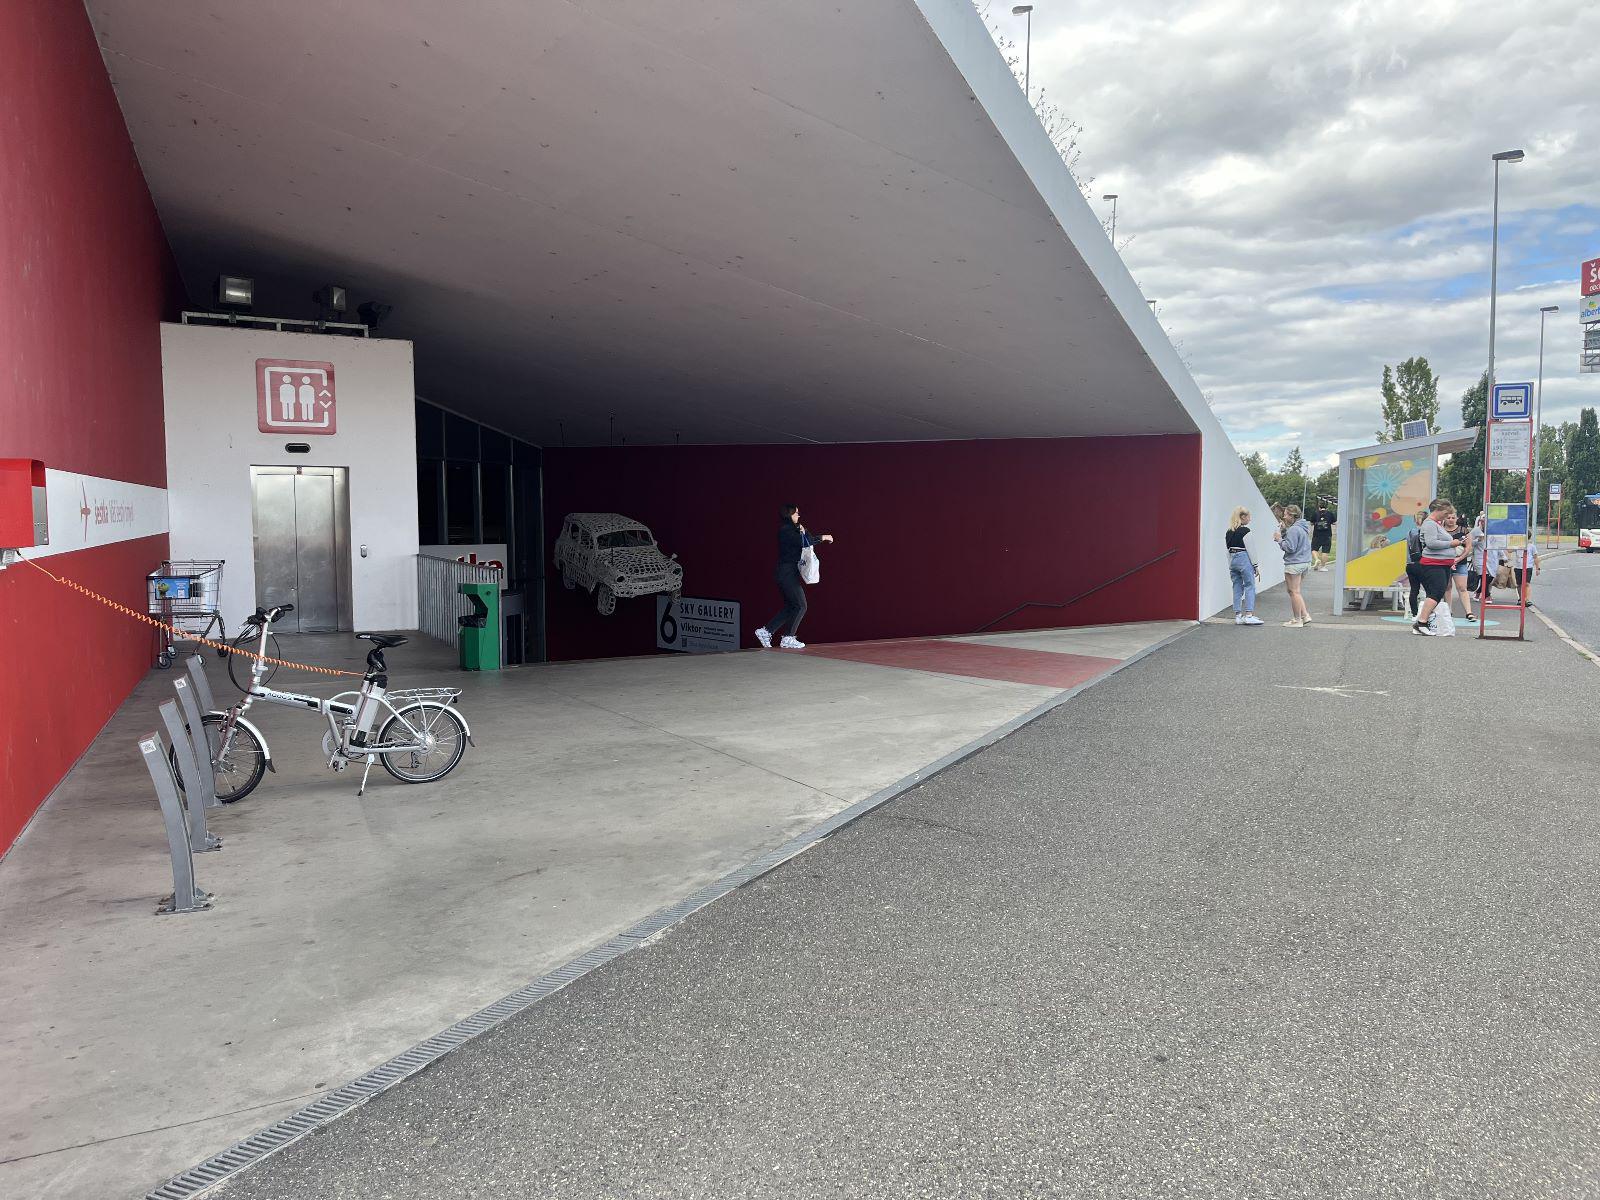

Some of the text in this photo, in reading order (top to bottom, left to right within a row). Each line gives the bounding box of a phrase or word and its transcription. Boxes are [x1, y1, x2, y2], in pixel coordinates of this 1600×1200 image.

[680, 603, 734, 619] SKY GALLERY
[681, 623, 701, 633] Viktor
